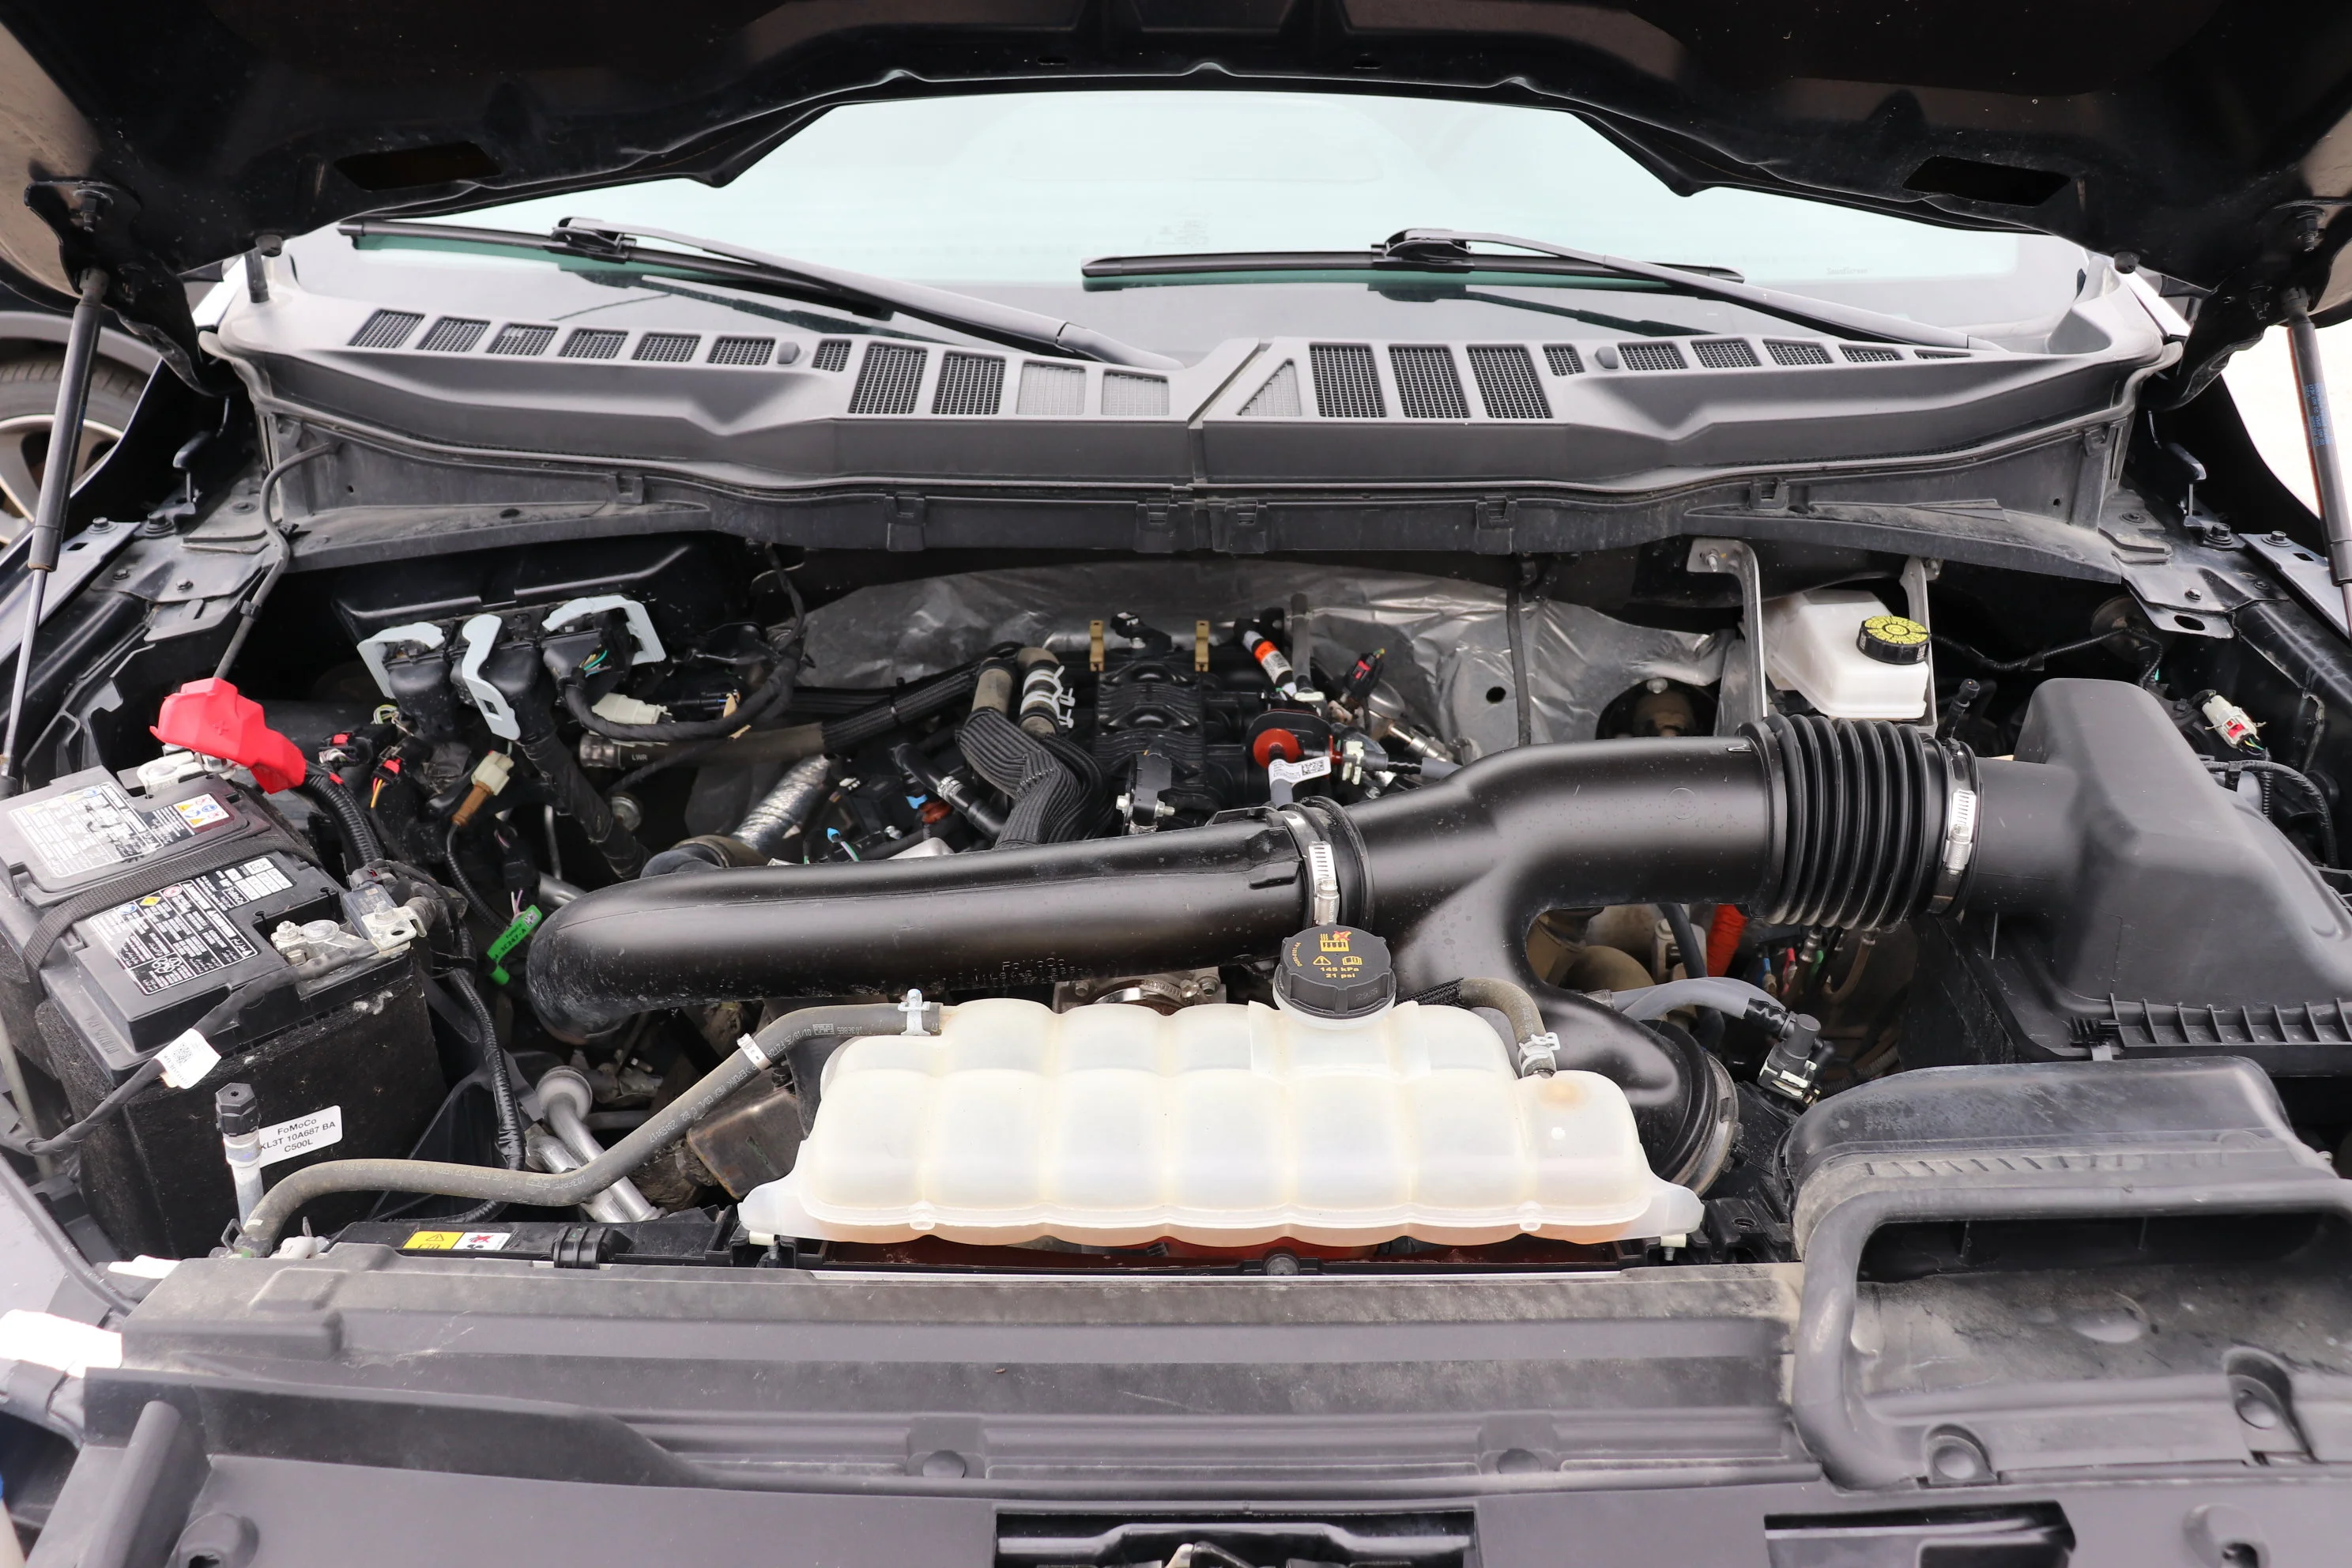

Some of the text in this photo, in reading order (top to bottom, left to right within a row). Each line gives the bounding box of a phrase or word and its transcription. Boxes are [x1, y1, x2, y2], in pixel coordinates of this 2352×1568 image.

[277, 1118, 317, 1135] FoMoCo
[260, 1121, 336, 1150] KL3T 10A687 BA
[284, 1139, 314, 1152] C500L
